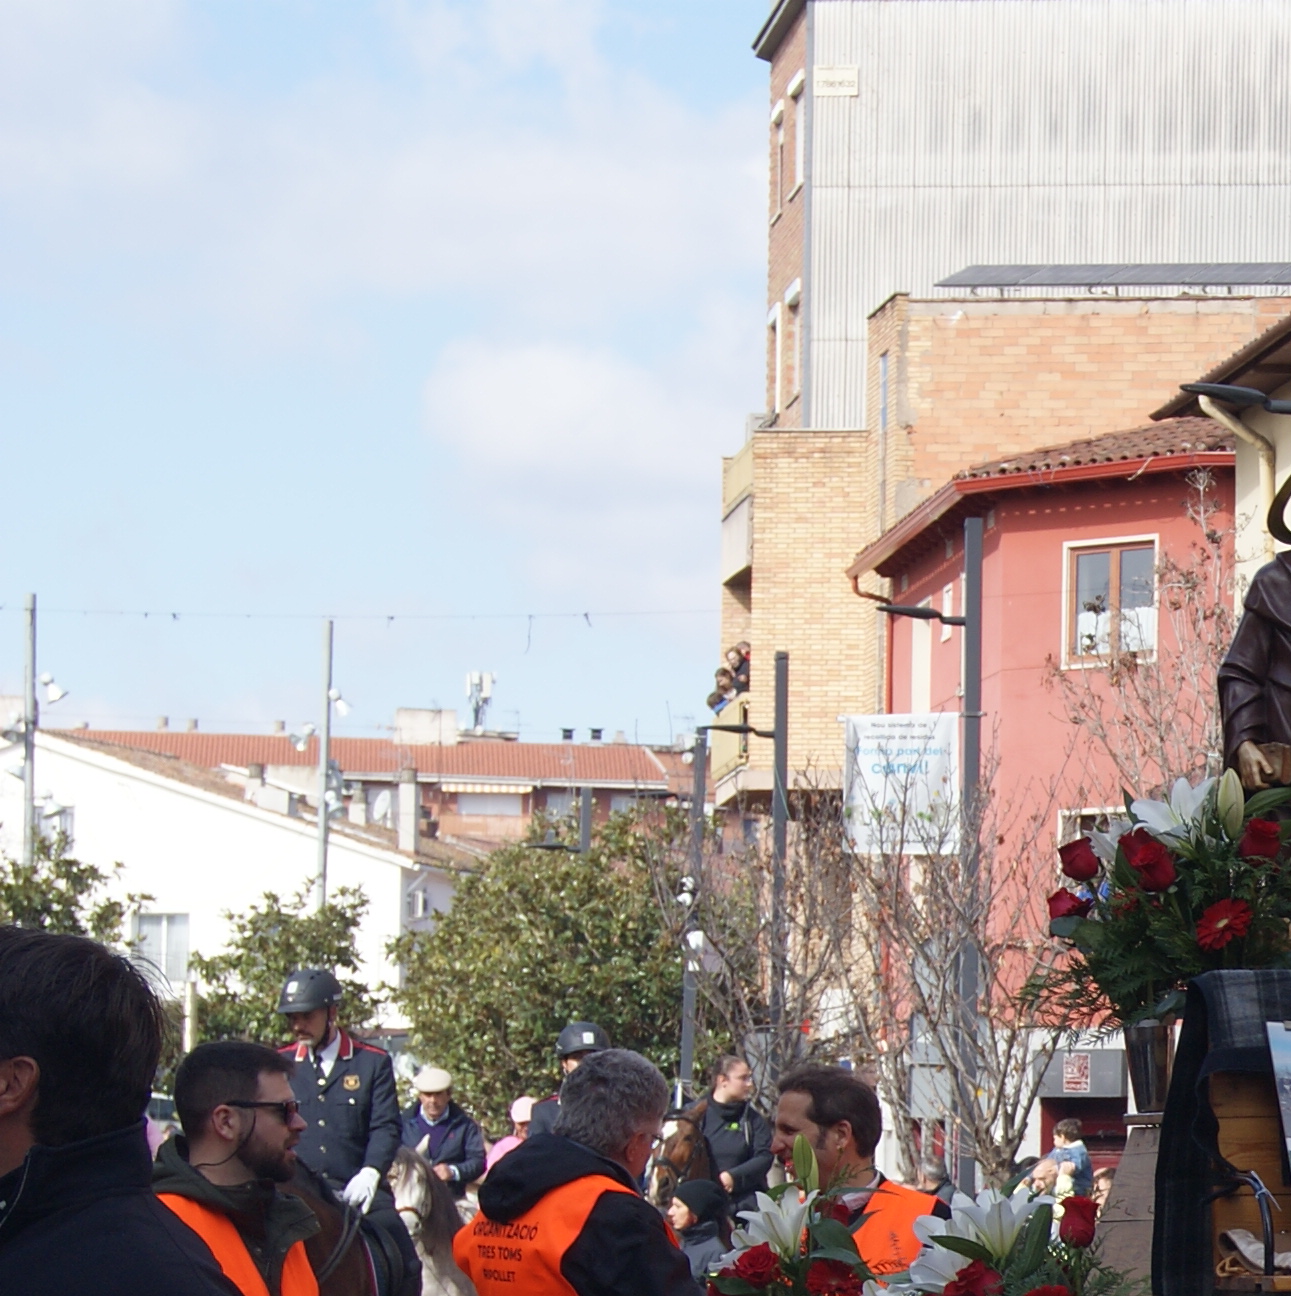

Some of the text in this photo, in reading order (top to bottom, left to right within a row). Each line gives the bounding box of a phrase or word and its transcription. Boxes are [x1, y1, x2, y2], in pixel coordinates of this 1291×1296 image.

[477, 1244, 522, 1261] TRES TOMS
[483, 1268, 516, 1283] RIPOLLET
